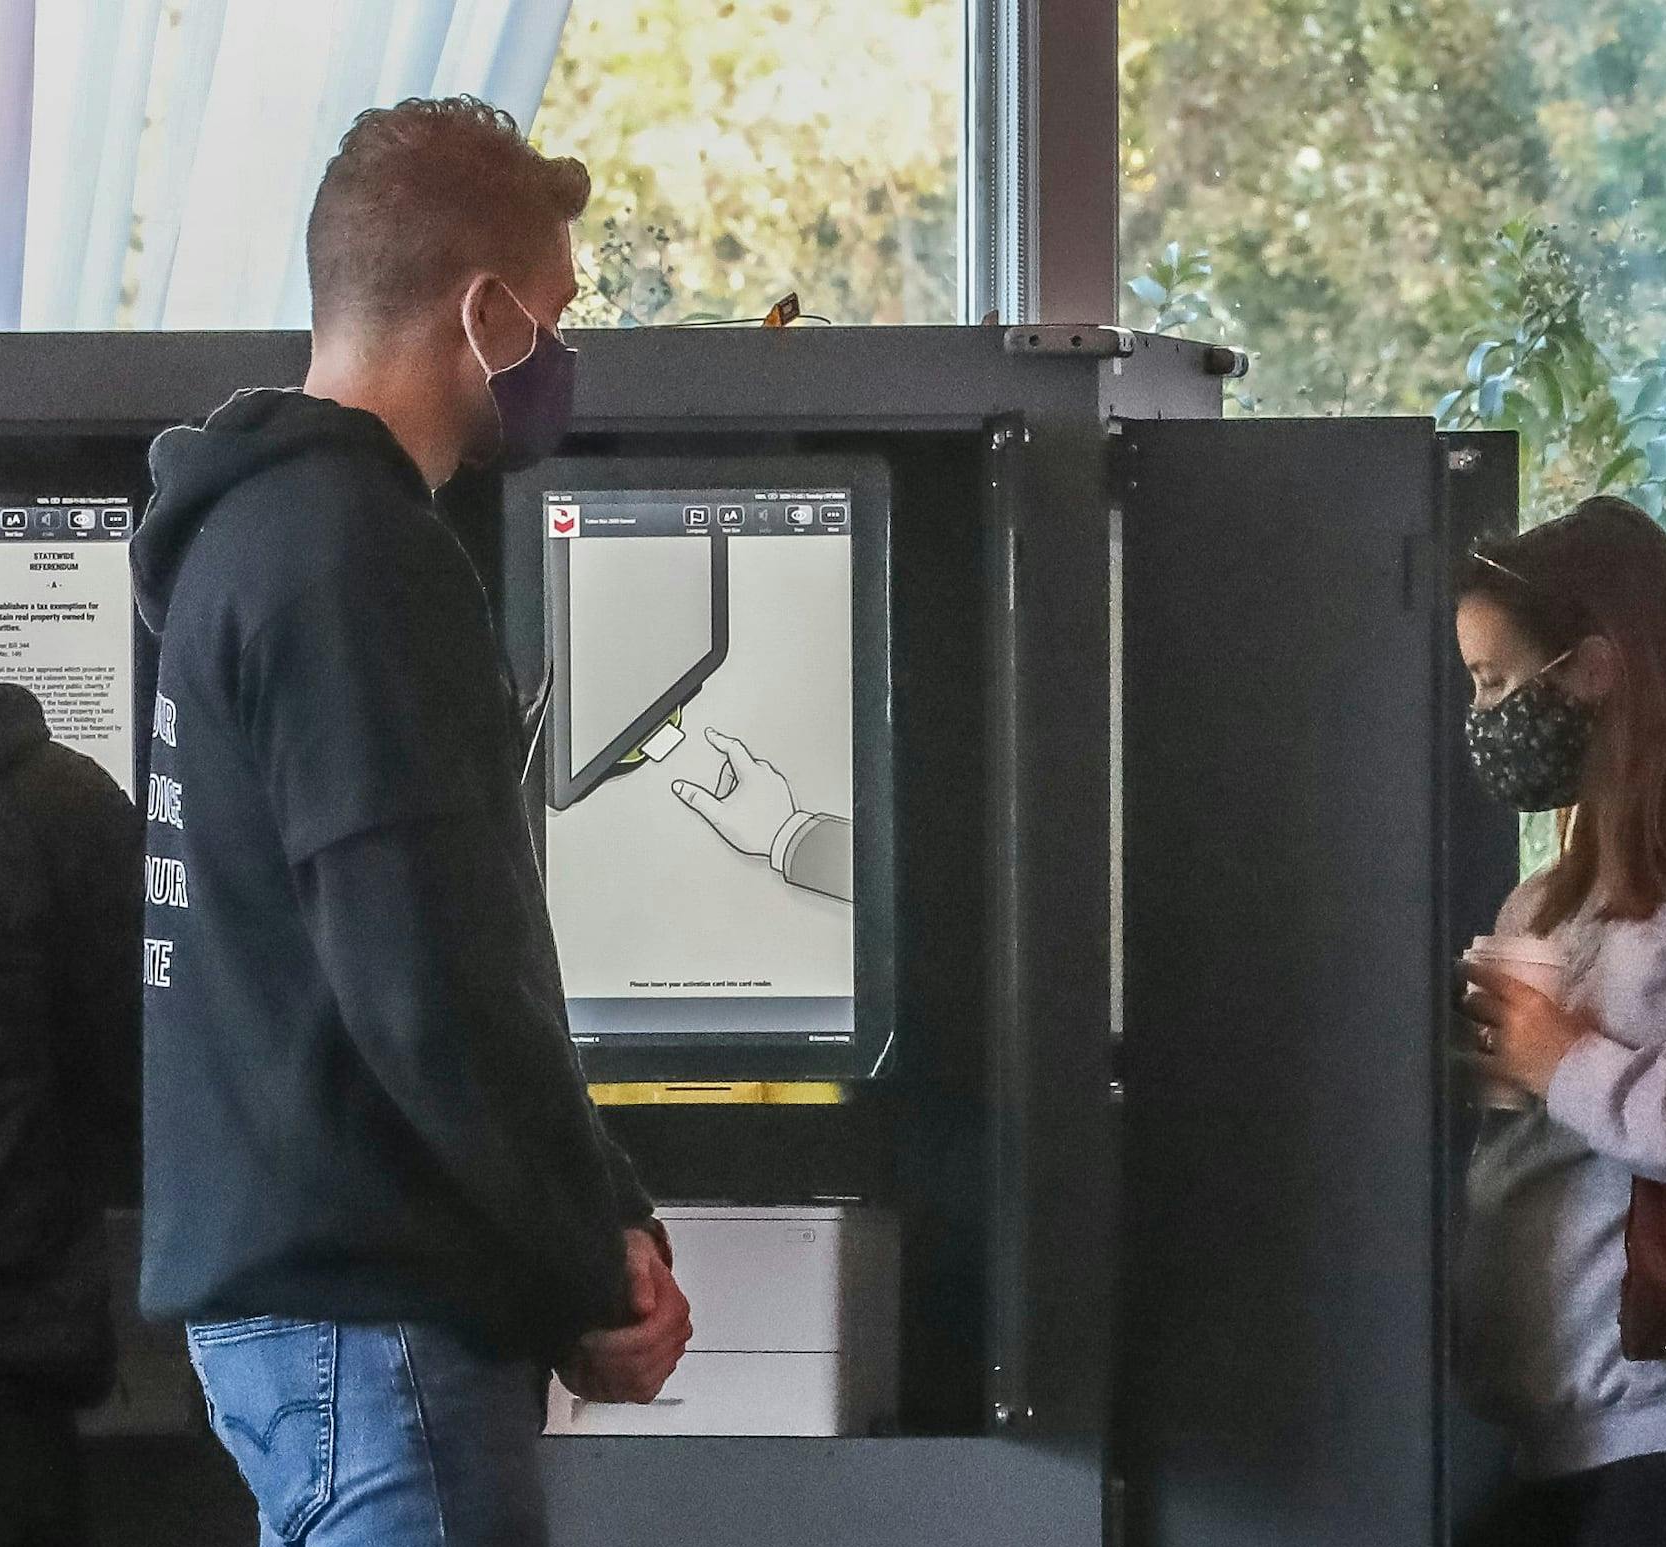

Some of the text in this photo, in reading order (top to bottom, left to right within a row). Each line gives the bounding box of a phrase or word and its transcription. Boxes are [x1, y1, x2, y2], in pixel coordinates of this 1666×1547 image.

[33, 552, 74, 560] STATEWIDE
[29, 563, 79, 571] REFERENDUM
[36, 602, 48, 610] tax
[50, 602, 87, 611] exemption
[88, 602, 99, 610] for
[15, 613, 29, 621] real
[30, 614, 60, 623] property
[61, 613, 85, 621] owned
[86, 612, 95, 623] by
[143, 938, 173, 988] TE
